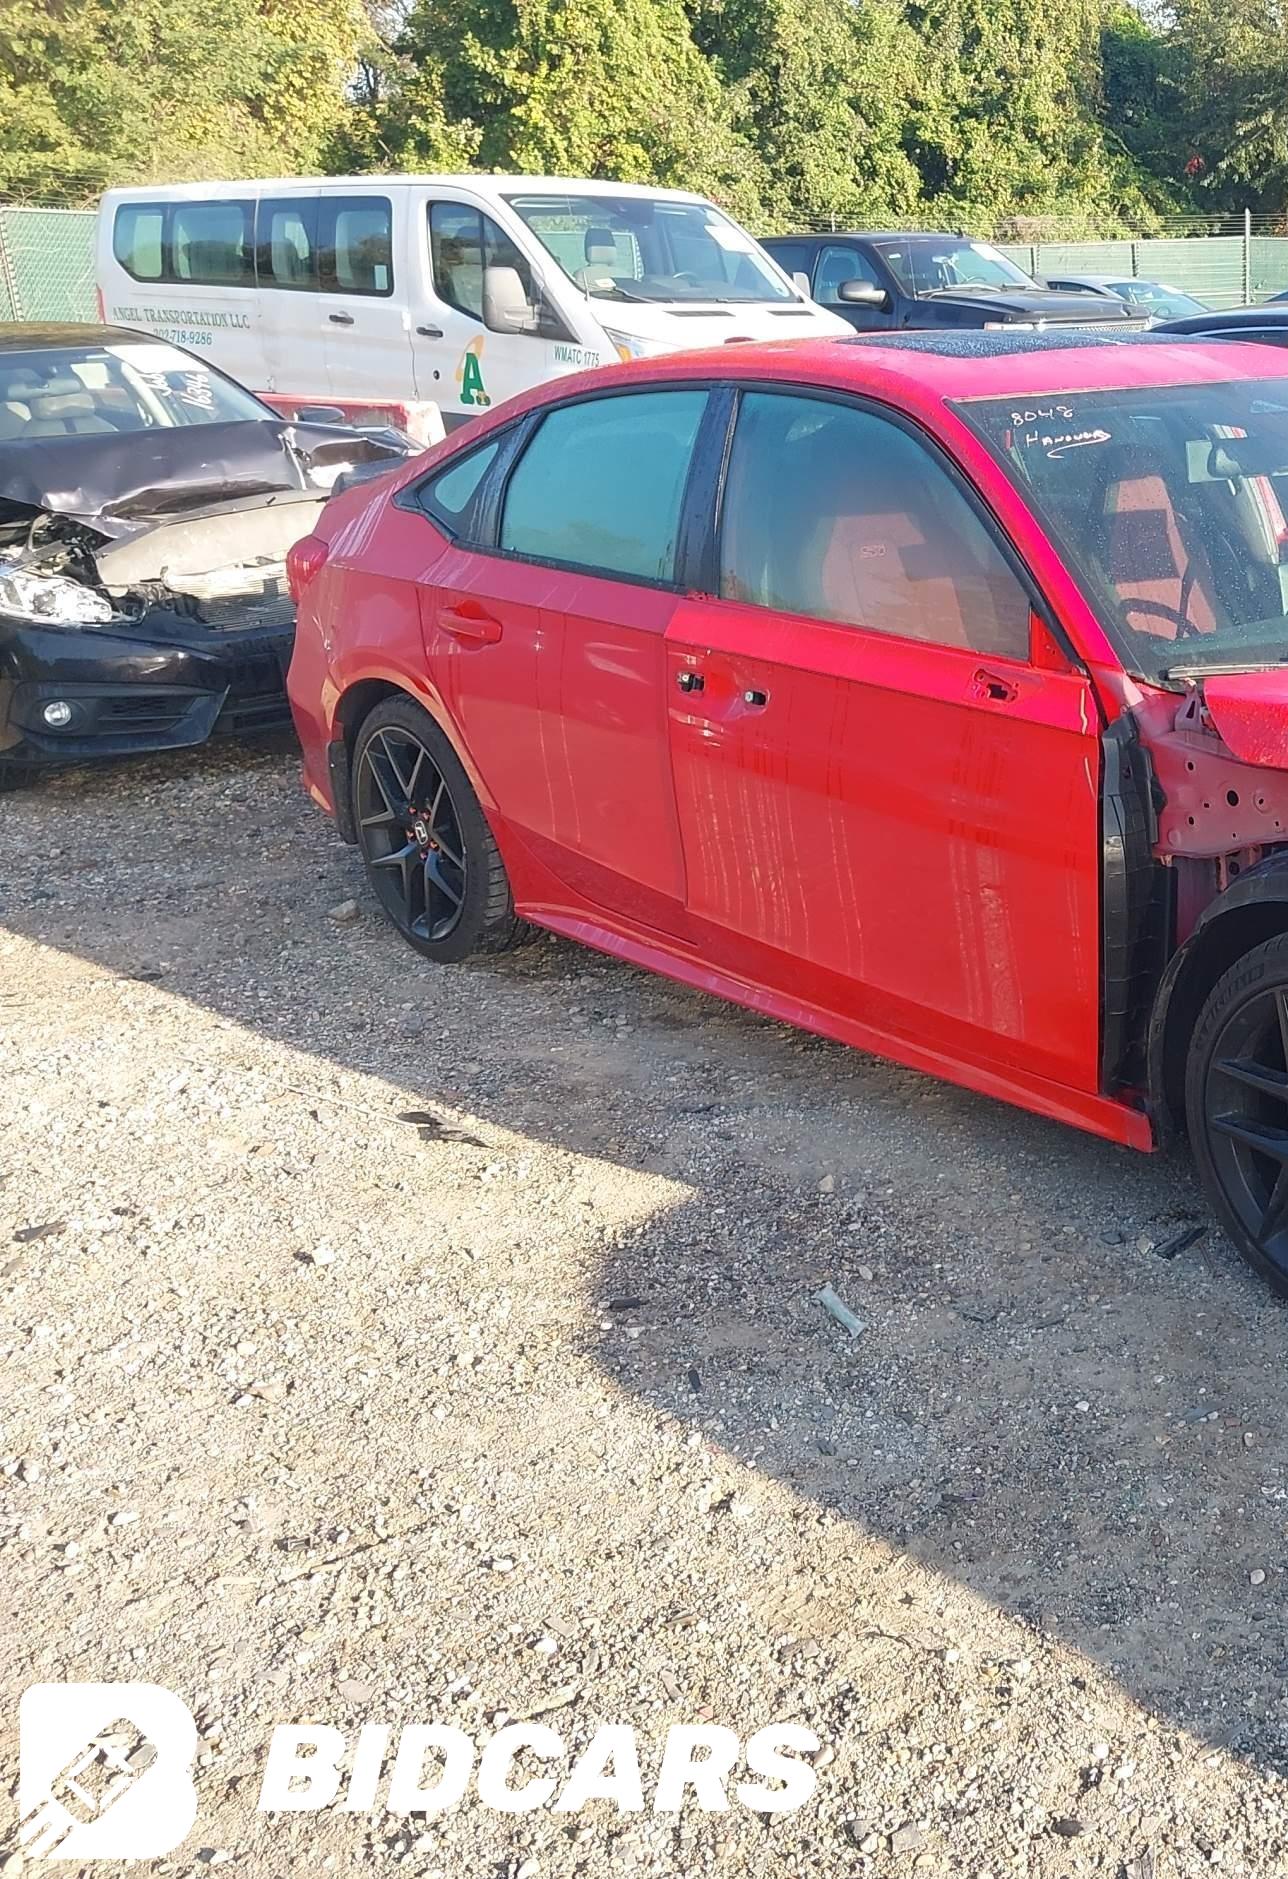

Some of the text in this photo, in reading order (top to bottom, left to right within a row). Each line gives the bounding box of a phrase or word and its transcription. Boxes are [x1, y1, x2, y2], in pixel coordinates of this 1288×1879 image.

[112, 307, 251, 329] ANGEL TRANSPORTATION LLC
[554, 345, 600, 367] WMATC 1775
[459, 352, 491, 406] A
[1011, 405, 1074, 426] 8048
